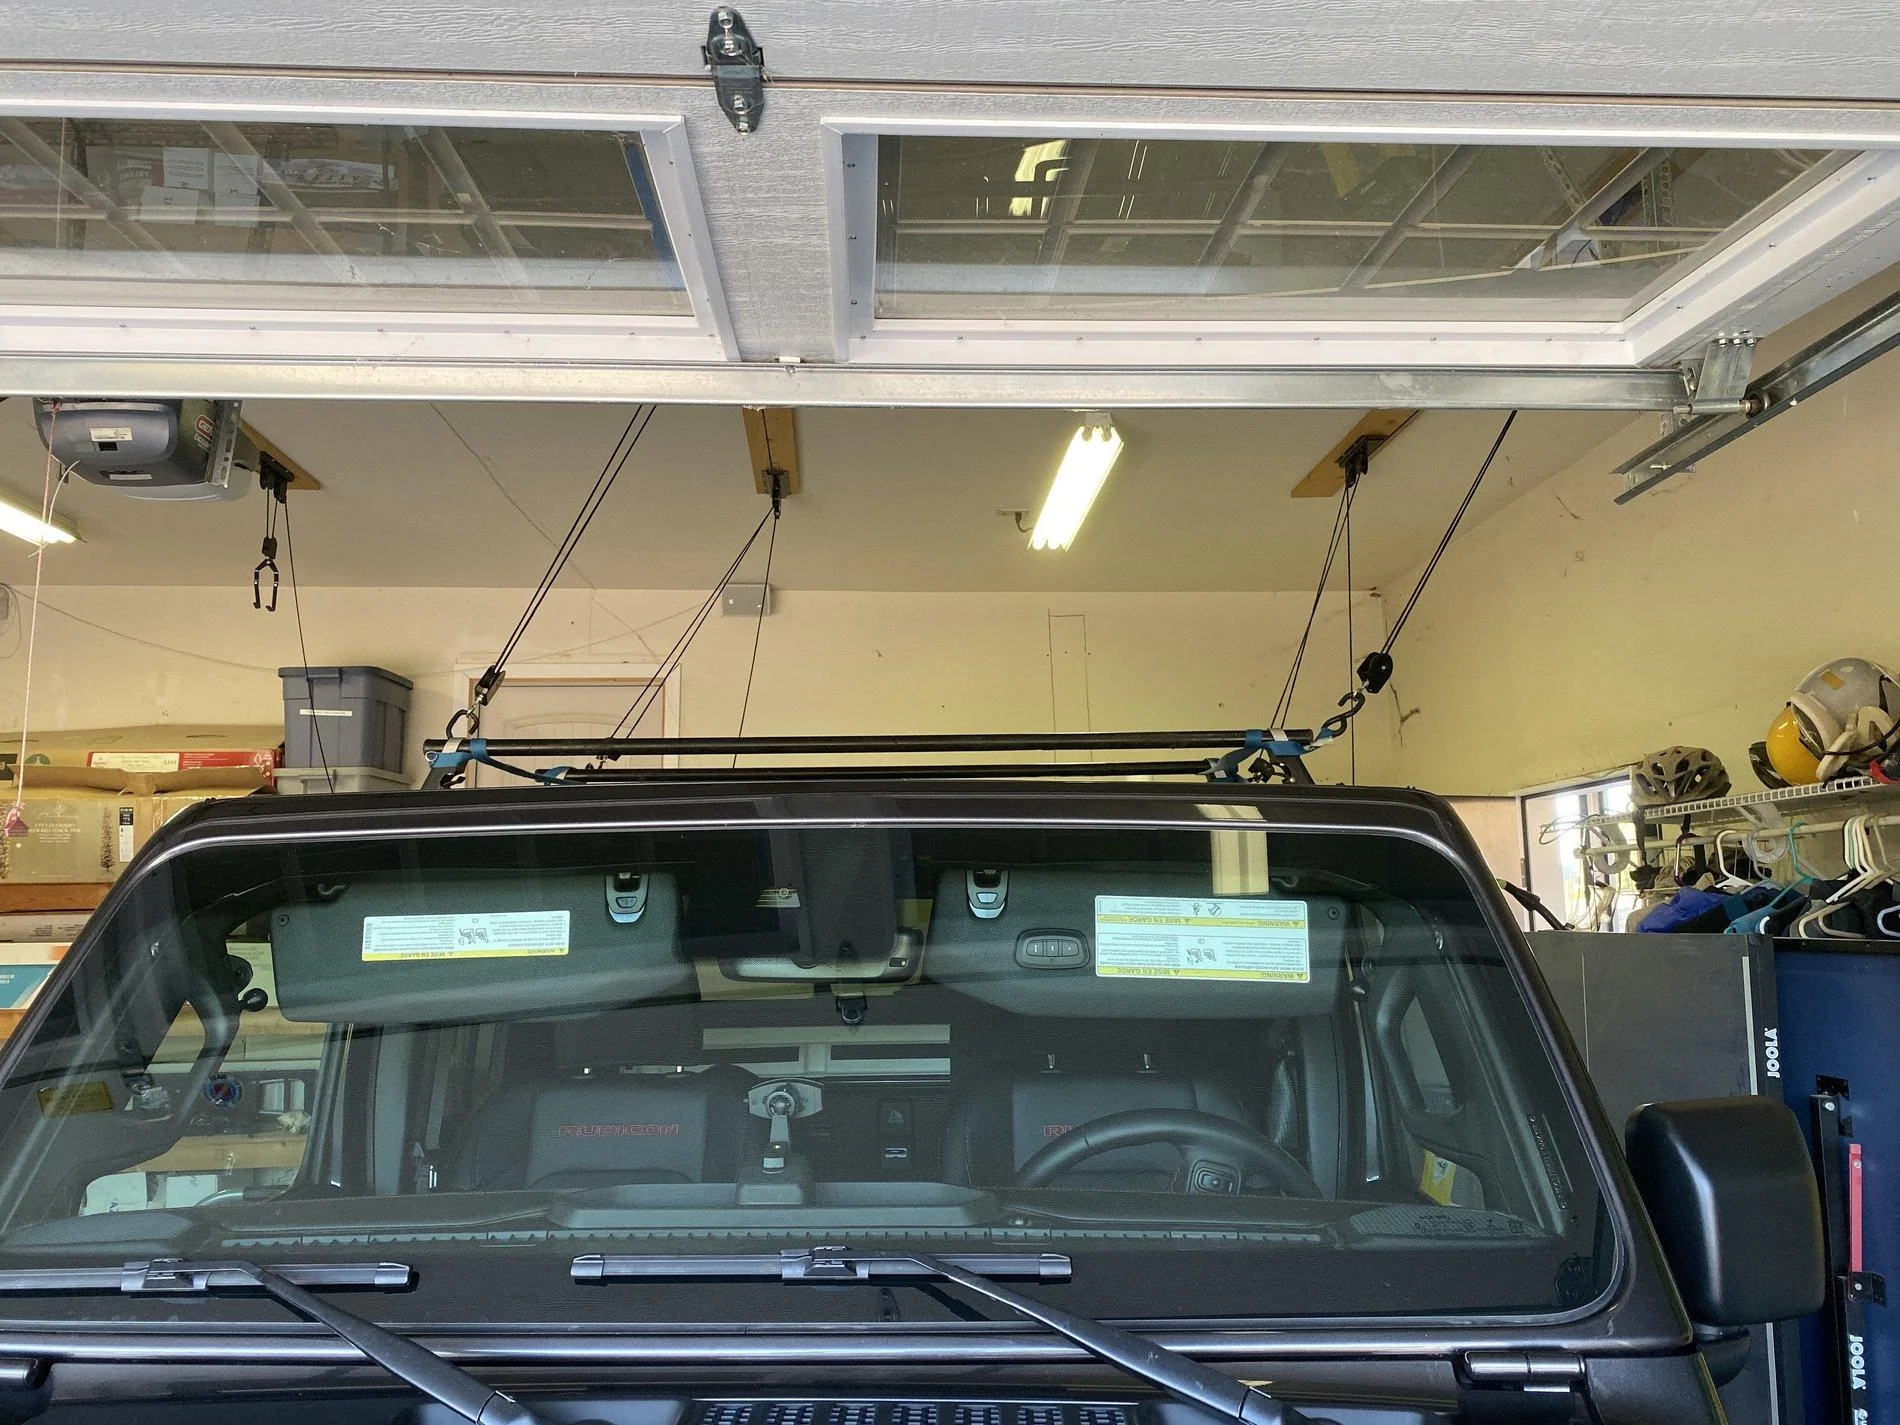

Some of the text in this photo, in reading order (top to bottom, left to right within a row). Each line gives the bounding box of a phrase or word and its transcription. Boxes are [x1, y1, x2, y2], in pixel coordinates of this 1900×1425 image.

[1261, 972, 1294, 980] WARNING
[1764, 1027, 1780, 1079] JOOLA
[558, 1123, 679, 1137] RUBICON
[1849, 1333, 1867, 1390] JOOLA
